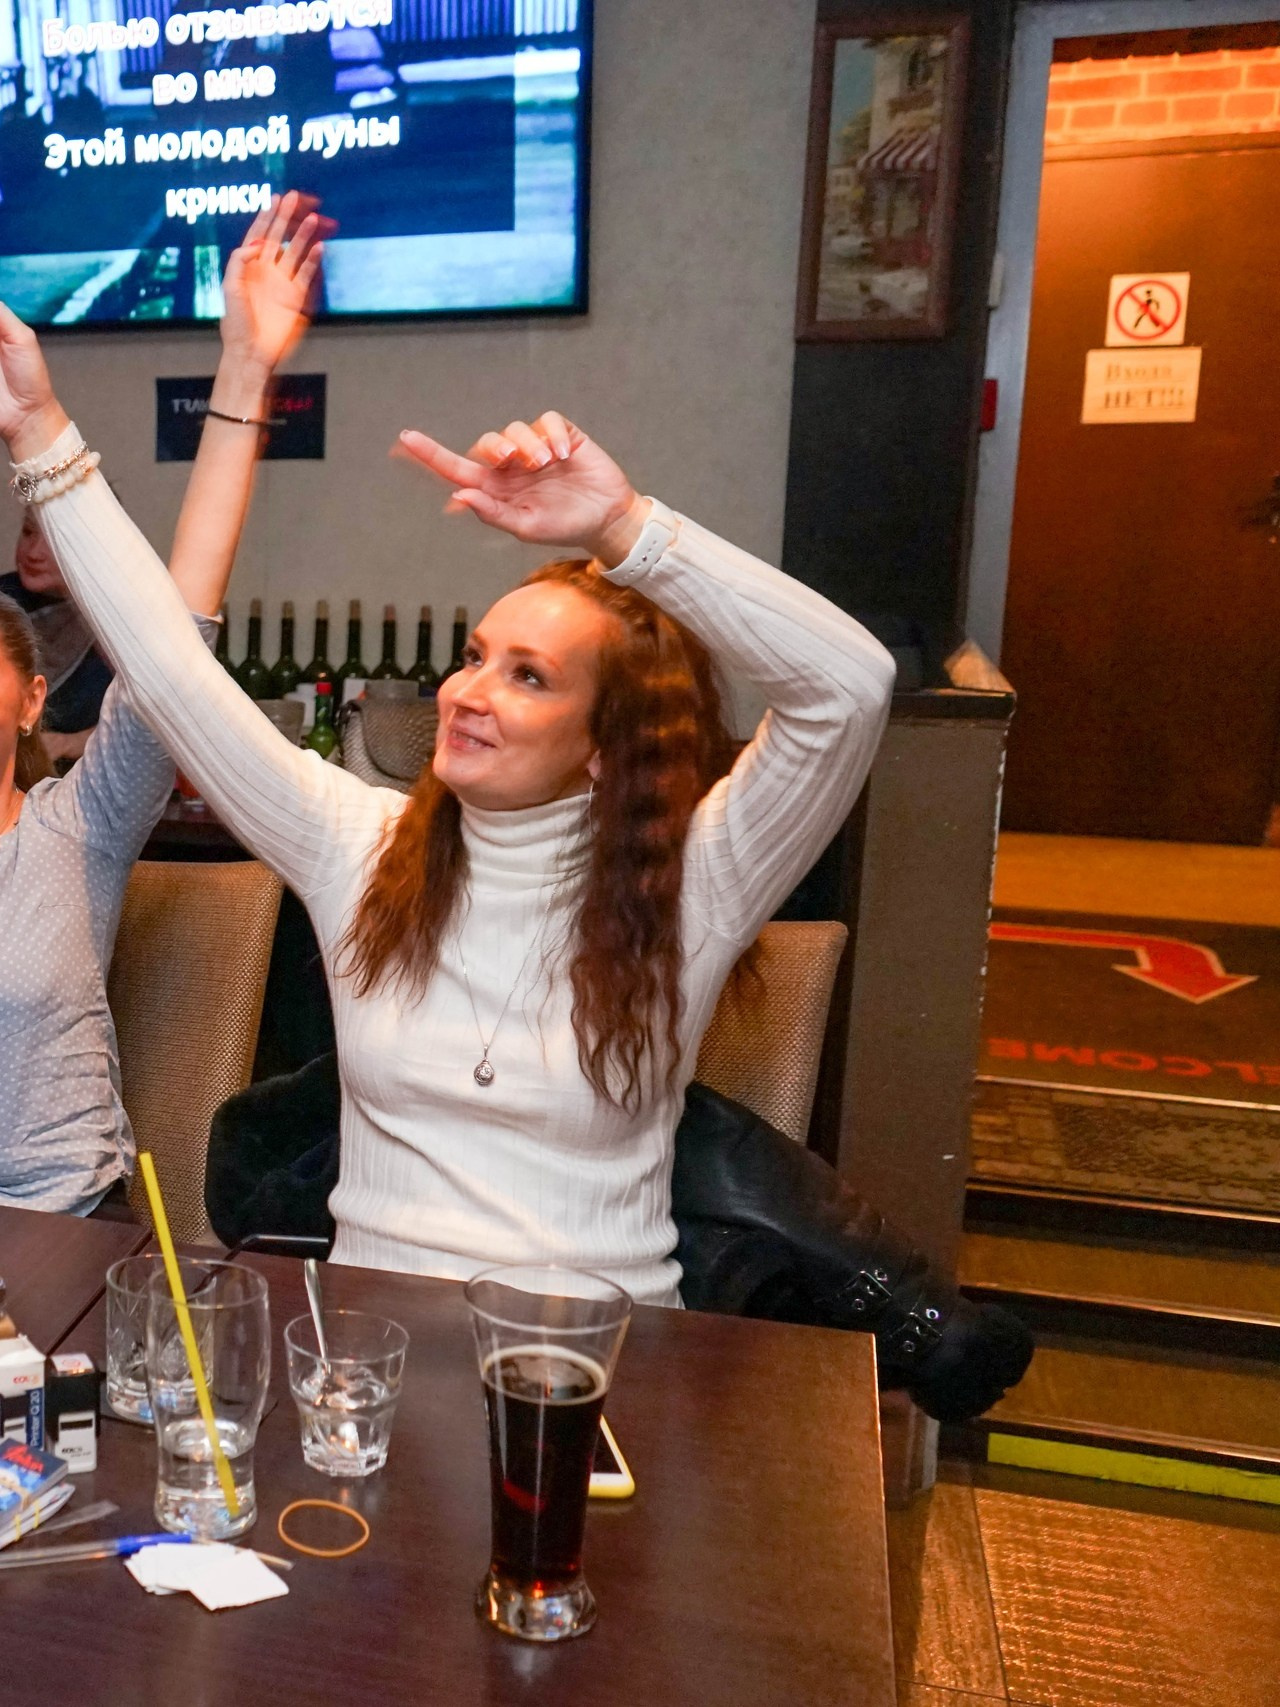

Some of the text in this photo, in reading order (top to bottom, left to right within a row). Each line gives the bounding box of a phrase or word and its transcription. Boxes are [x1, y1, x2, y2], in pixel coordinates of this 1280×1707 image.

[42, 0, 393, 58] Болью отзываются
[153, 65, 276, 105] во мне
[44, 115, 400, 169] Этой молодой луны
[166, 183, 271, 224] крики
[30, 1390, 41, 1404] 20
